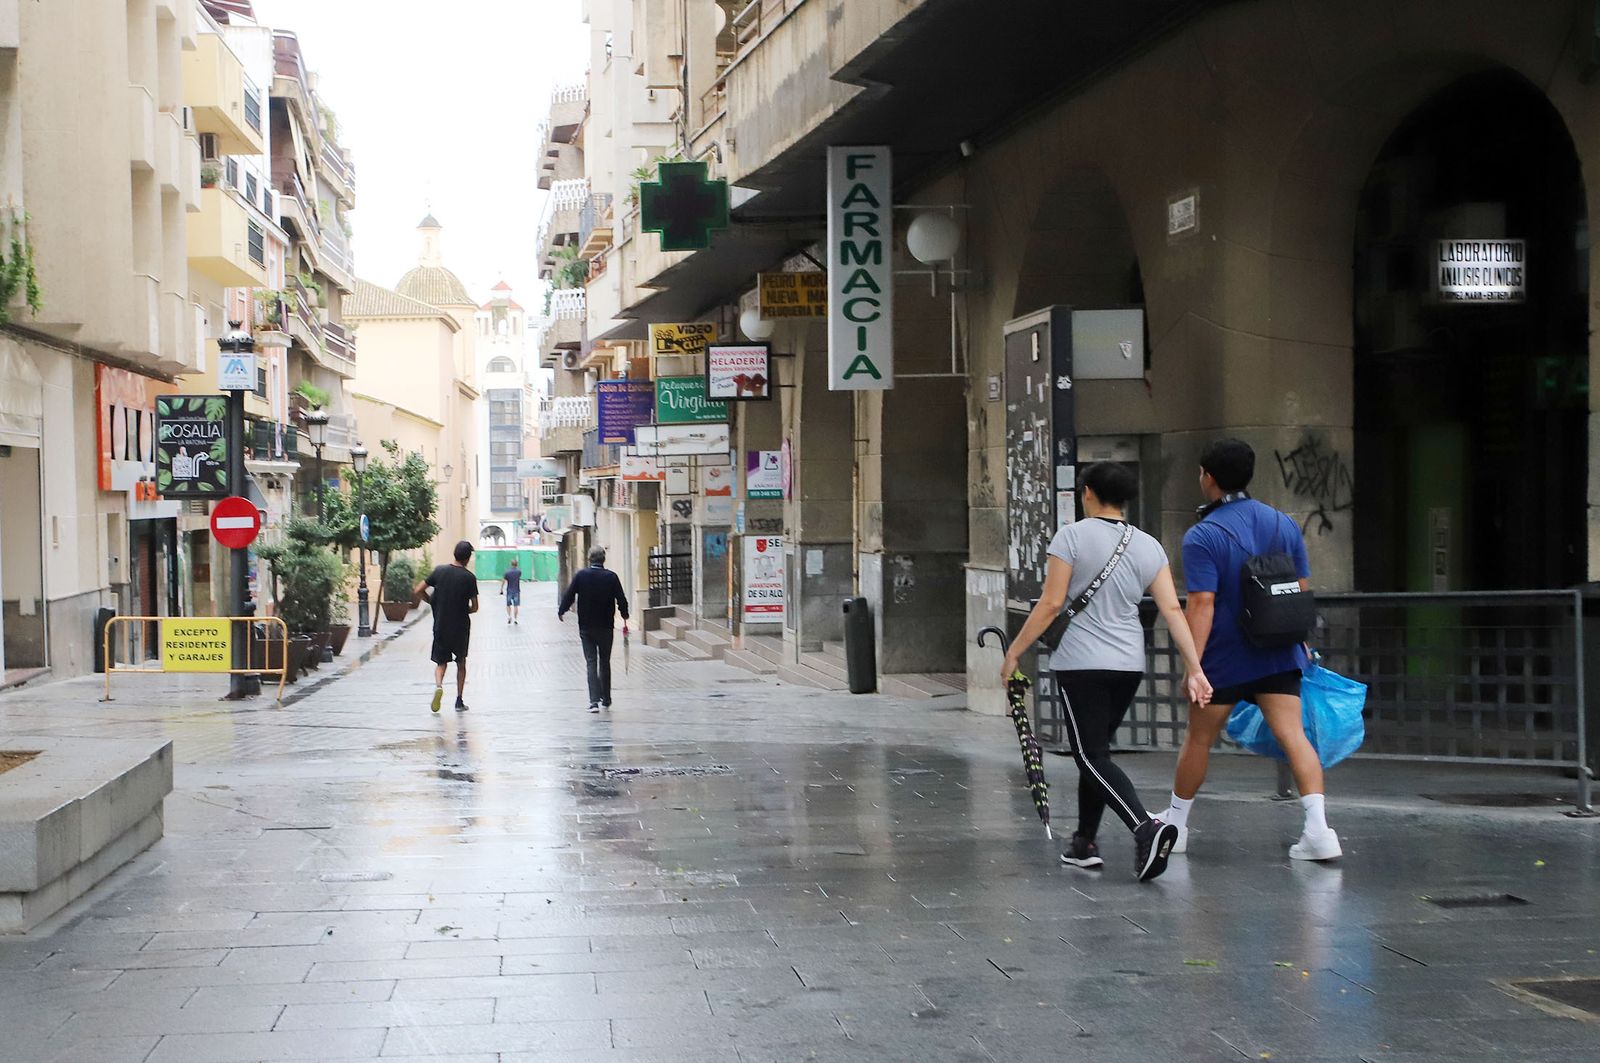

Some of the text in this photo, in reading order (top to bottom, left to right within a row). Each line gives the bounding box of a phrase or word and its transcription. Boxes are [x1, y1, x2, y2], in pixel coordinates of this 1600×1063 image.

[1440, 242, 1523, 262] LABORATORIO
[840, 154, 882, 380] FARMACIA
[767, 290, 799, 304] NUEVA
[710, 357, 766, 366] HELADERIA
[1100, 554, 1121, 581] adidas
[748, 589, 758, 598] DE
[758, 589, 768, 598] SU
[174, 628, 219, 637] EXCEPTO
[165, 641, 227, 649] RESIDENTES
[169, 653, 224, 661] Y GARAJES
